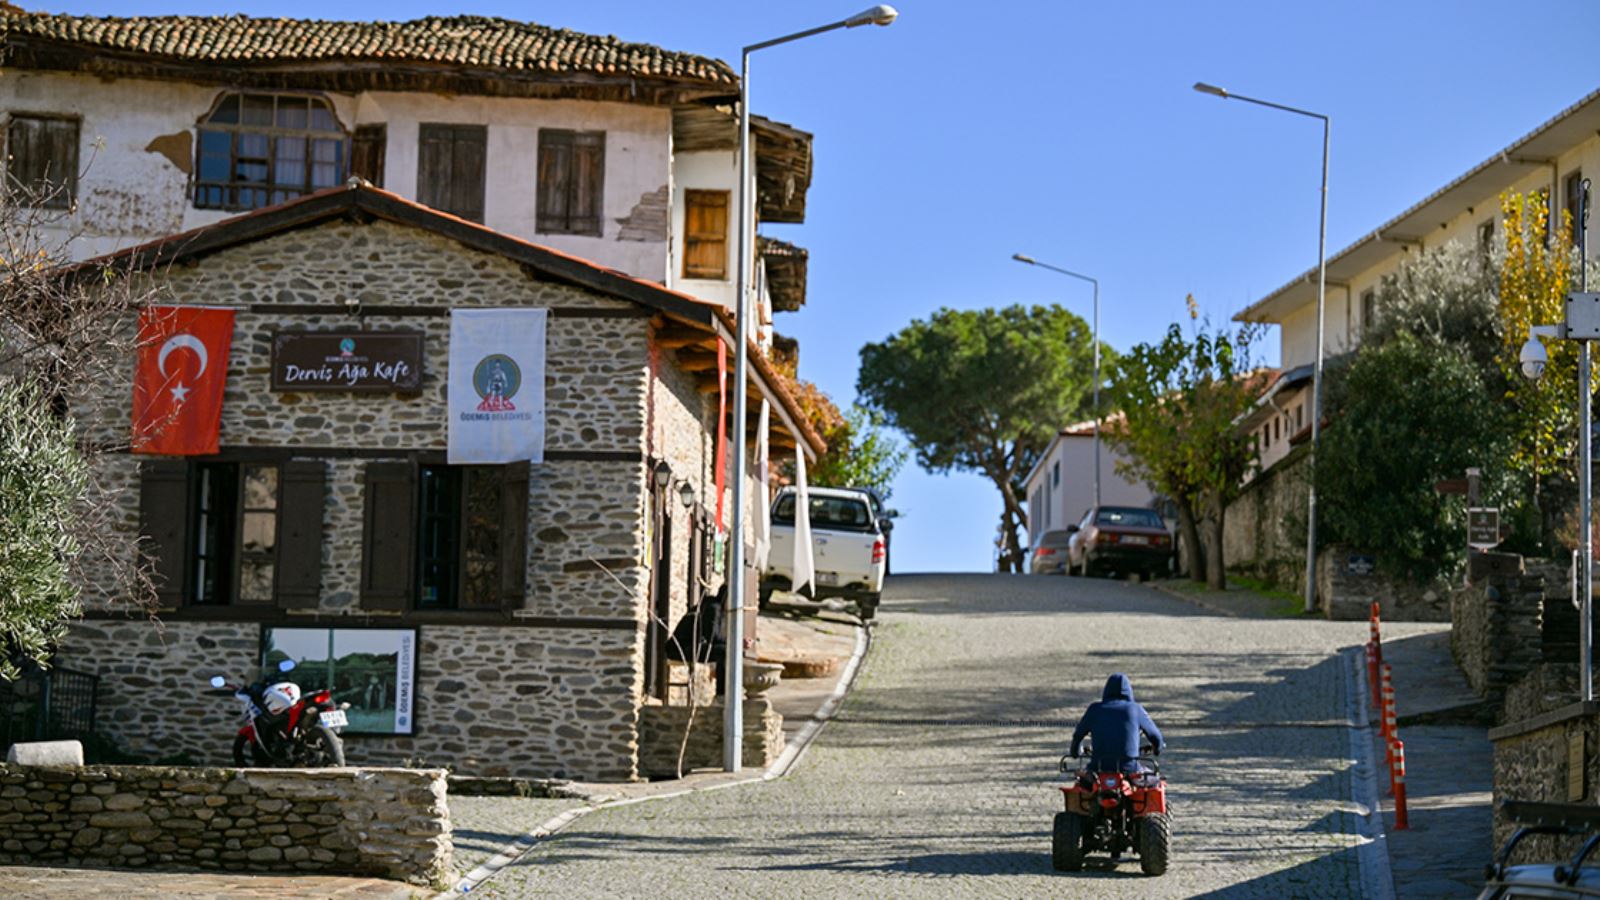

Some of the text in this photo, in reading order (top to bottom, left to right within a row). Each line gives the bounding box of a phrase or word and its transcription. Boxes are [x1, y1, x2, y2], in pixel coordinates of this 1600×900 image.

[285, 361, 409, 386] Derviş Ağa Kafe
